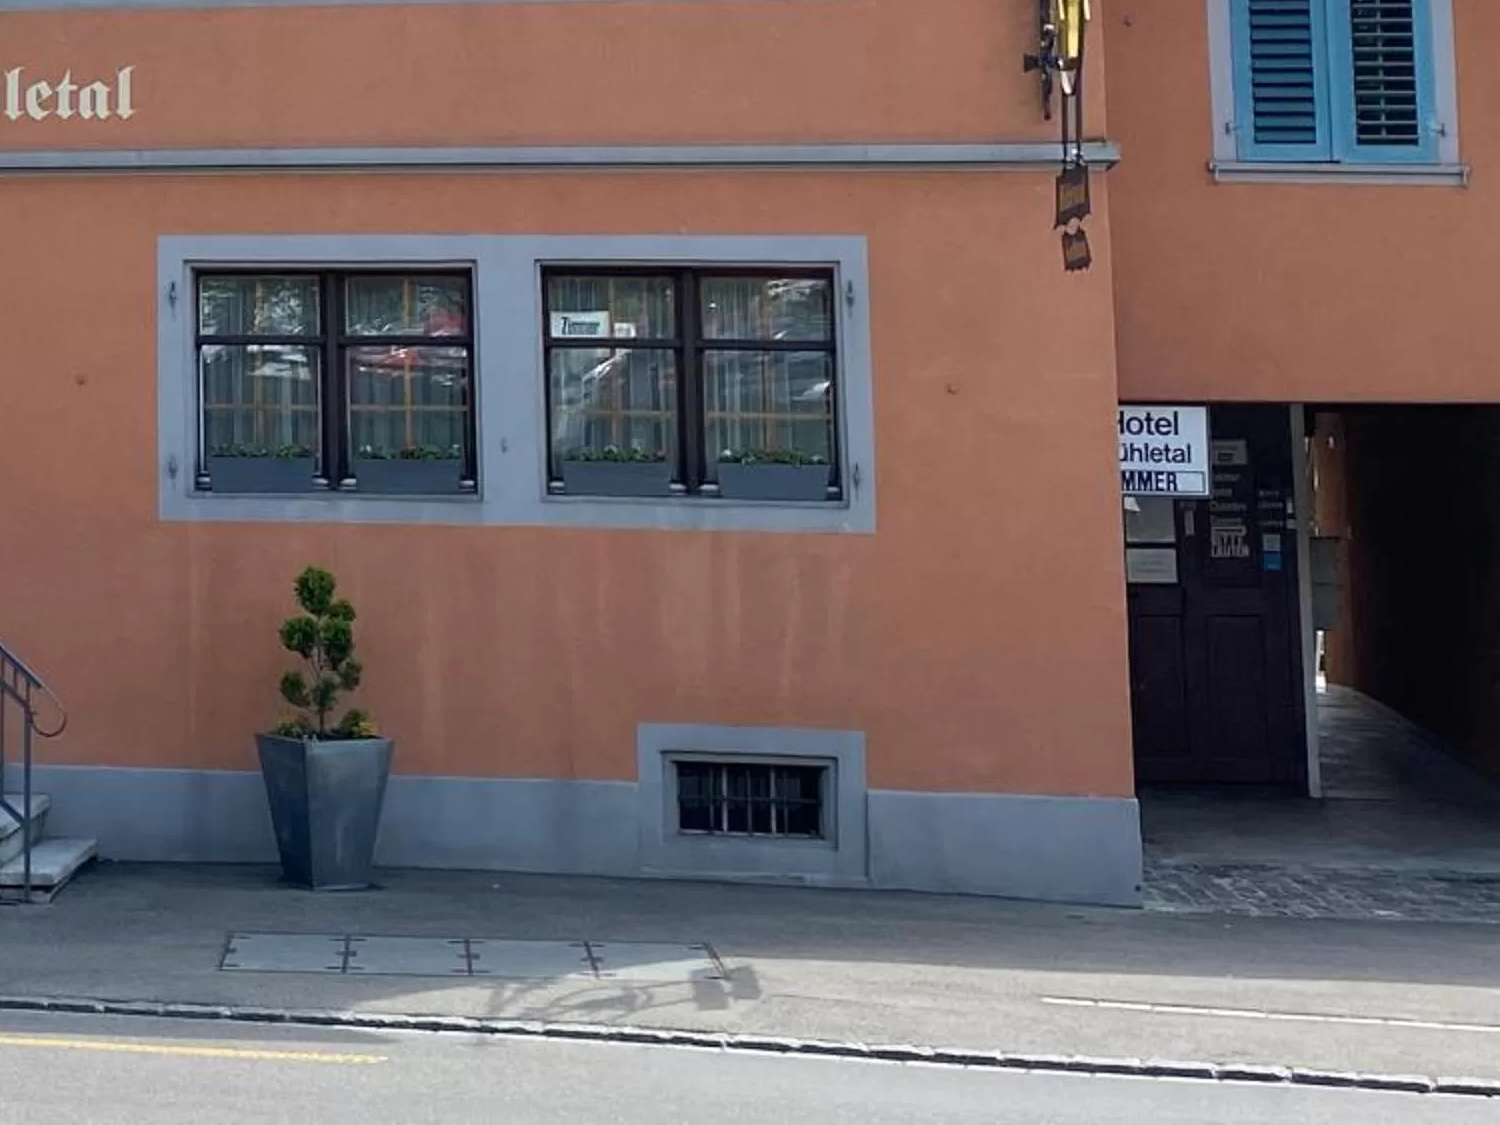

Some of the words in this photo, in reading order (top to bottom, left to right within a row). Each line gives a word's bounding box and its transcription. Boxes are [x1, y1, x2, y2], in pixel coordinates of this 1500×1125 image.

[1118, 411, 1179, 436] otel
[1119, 442, 1192, 464] ühletal
[1121, 471, 1179, 491] MMER
